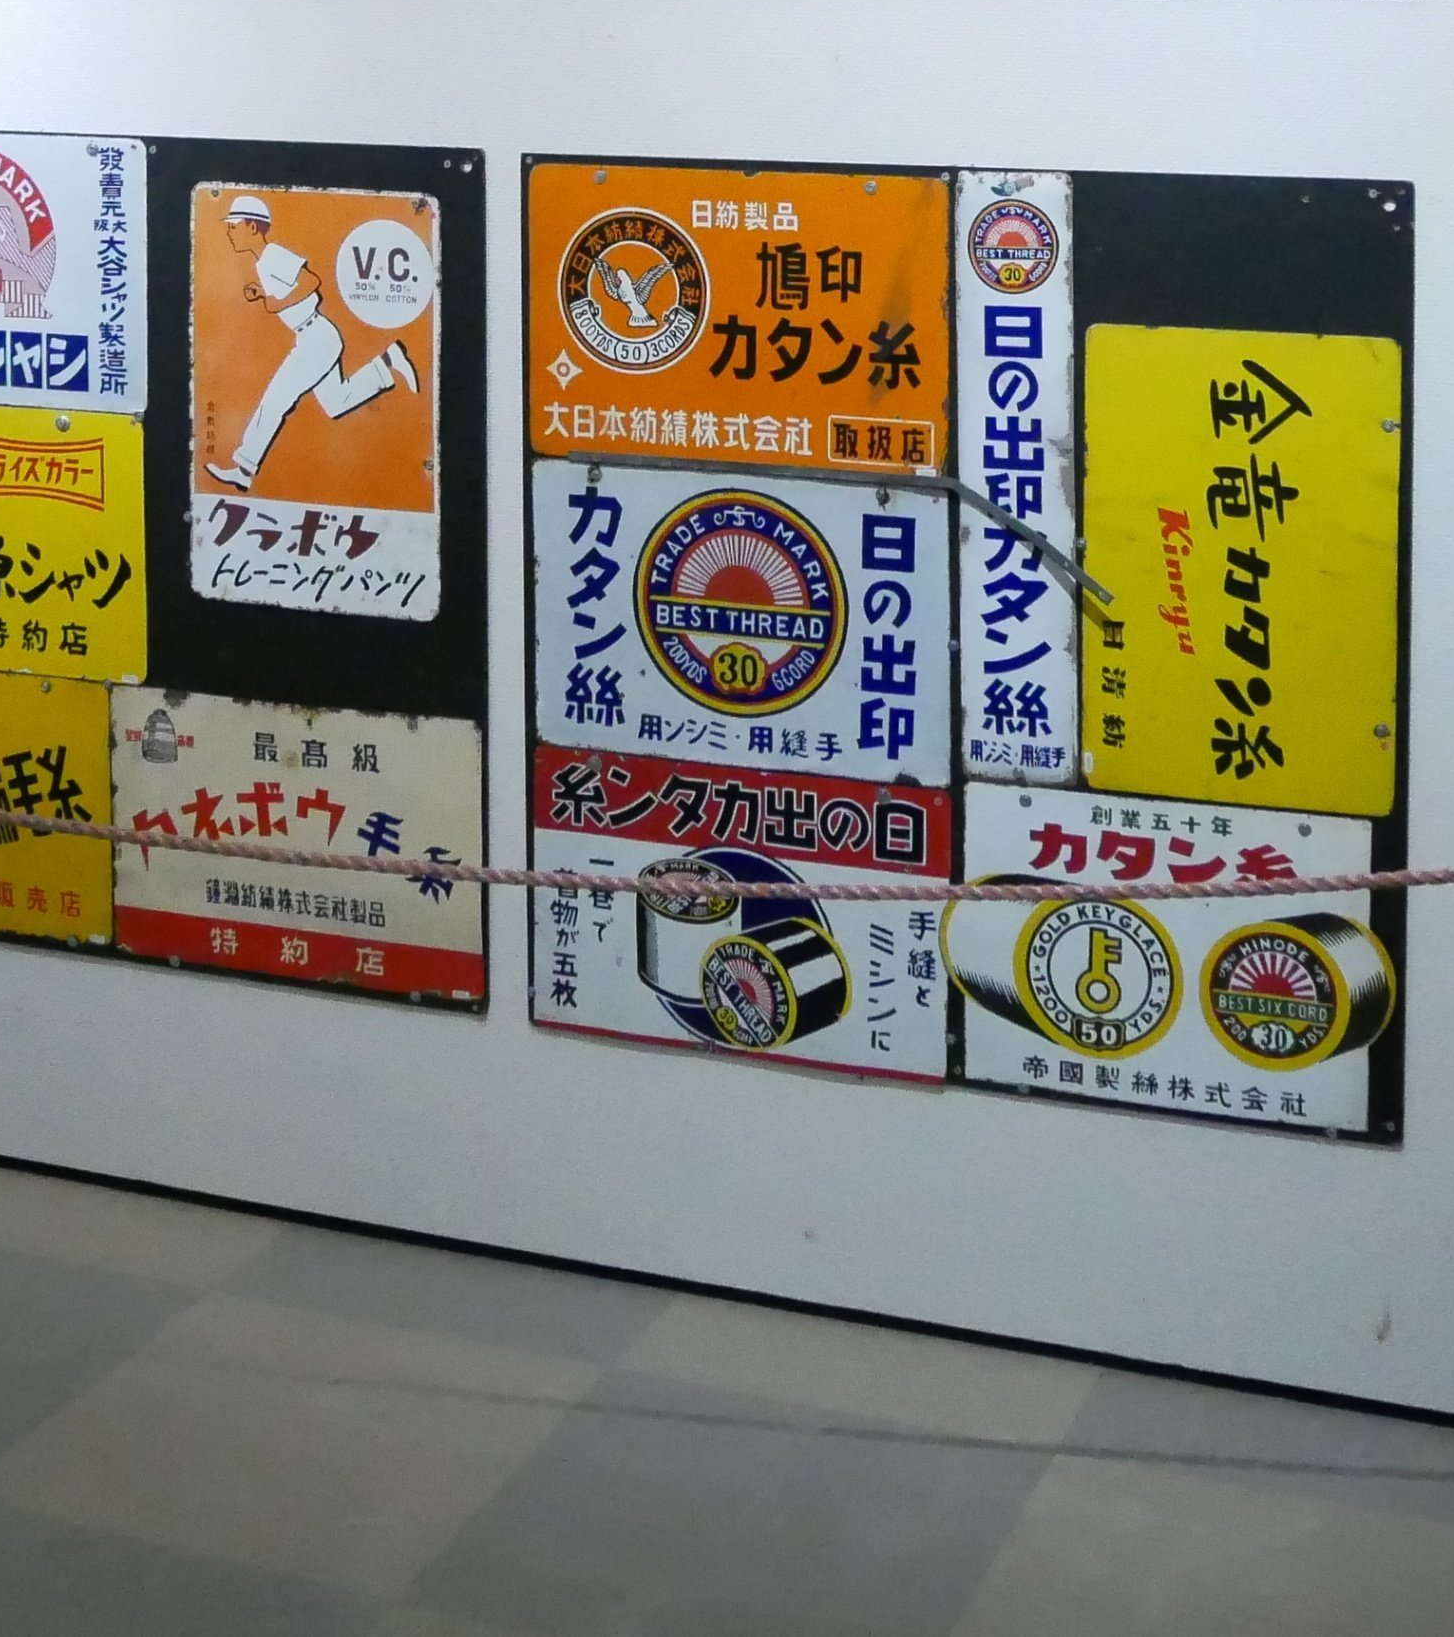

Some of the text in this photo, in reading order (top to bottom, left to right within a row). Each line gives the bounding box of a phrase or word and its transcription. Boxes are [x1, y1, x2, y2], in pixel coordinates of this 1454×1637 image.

[691, 200, 799, 232] 日紡製品
[974, 209, 1053, 245] TRADE MARK
[567, 220, 702, 307] 大日本紡績株式会社
[755, 241, 864, 311] 鳩印
[975, 248, 1052, 260] BEST THREAD
[1004, 267, 1022, 282] 30
[620, 342, 642, 360] 50
[709, 314, 922, 390] カタン糸
[543, 401, 813, 457] 大日本紡績株式会社
[832, 423, 926, 462] 取扱店
[209, 498, 380, 560] クラボウ
[211, 553, 427, 609] トレーニングパンツ
[650, 513, 830, 601] TRADE MARK
[1156, 506, 1196, 656] Kinryu
[655, 603, 825, 641] BEST THREAD
[856, 513, 917, 761] 日の出印
[719, 651, 760, 688] 30
[1101, 619, 1127, 751] 日清紡
[1090, 804, 1234, 837] 創業五十年
[209, 926, 385, 976] 特約店
[1032, 904, 1117, 959] GOLD KEY
[1238, 937, 1311, 963] HINODE
[719, 945, 787, 1024] TRADE MARK
[908, 911, 936, 1008] 手縫と
[707, 958, 735, 990] BEST
[733, 990, 773, 1042] THREAD
[868, 923, 898, 1052] ミシンに
[1032, 974, 1117, 1045] 1200 50
[1218, 994, 1329, 1022] BEST SIX CORD
[719, 1008, 735, 1025] 30
[1222, 1016, 1288, 1050] 200 30
